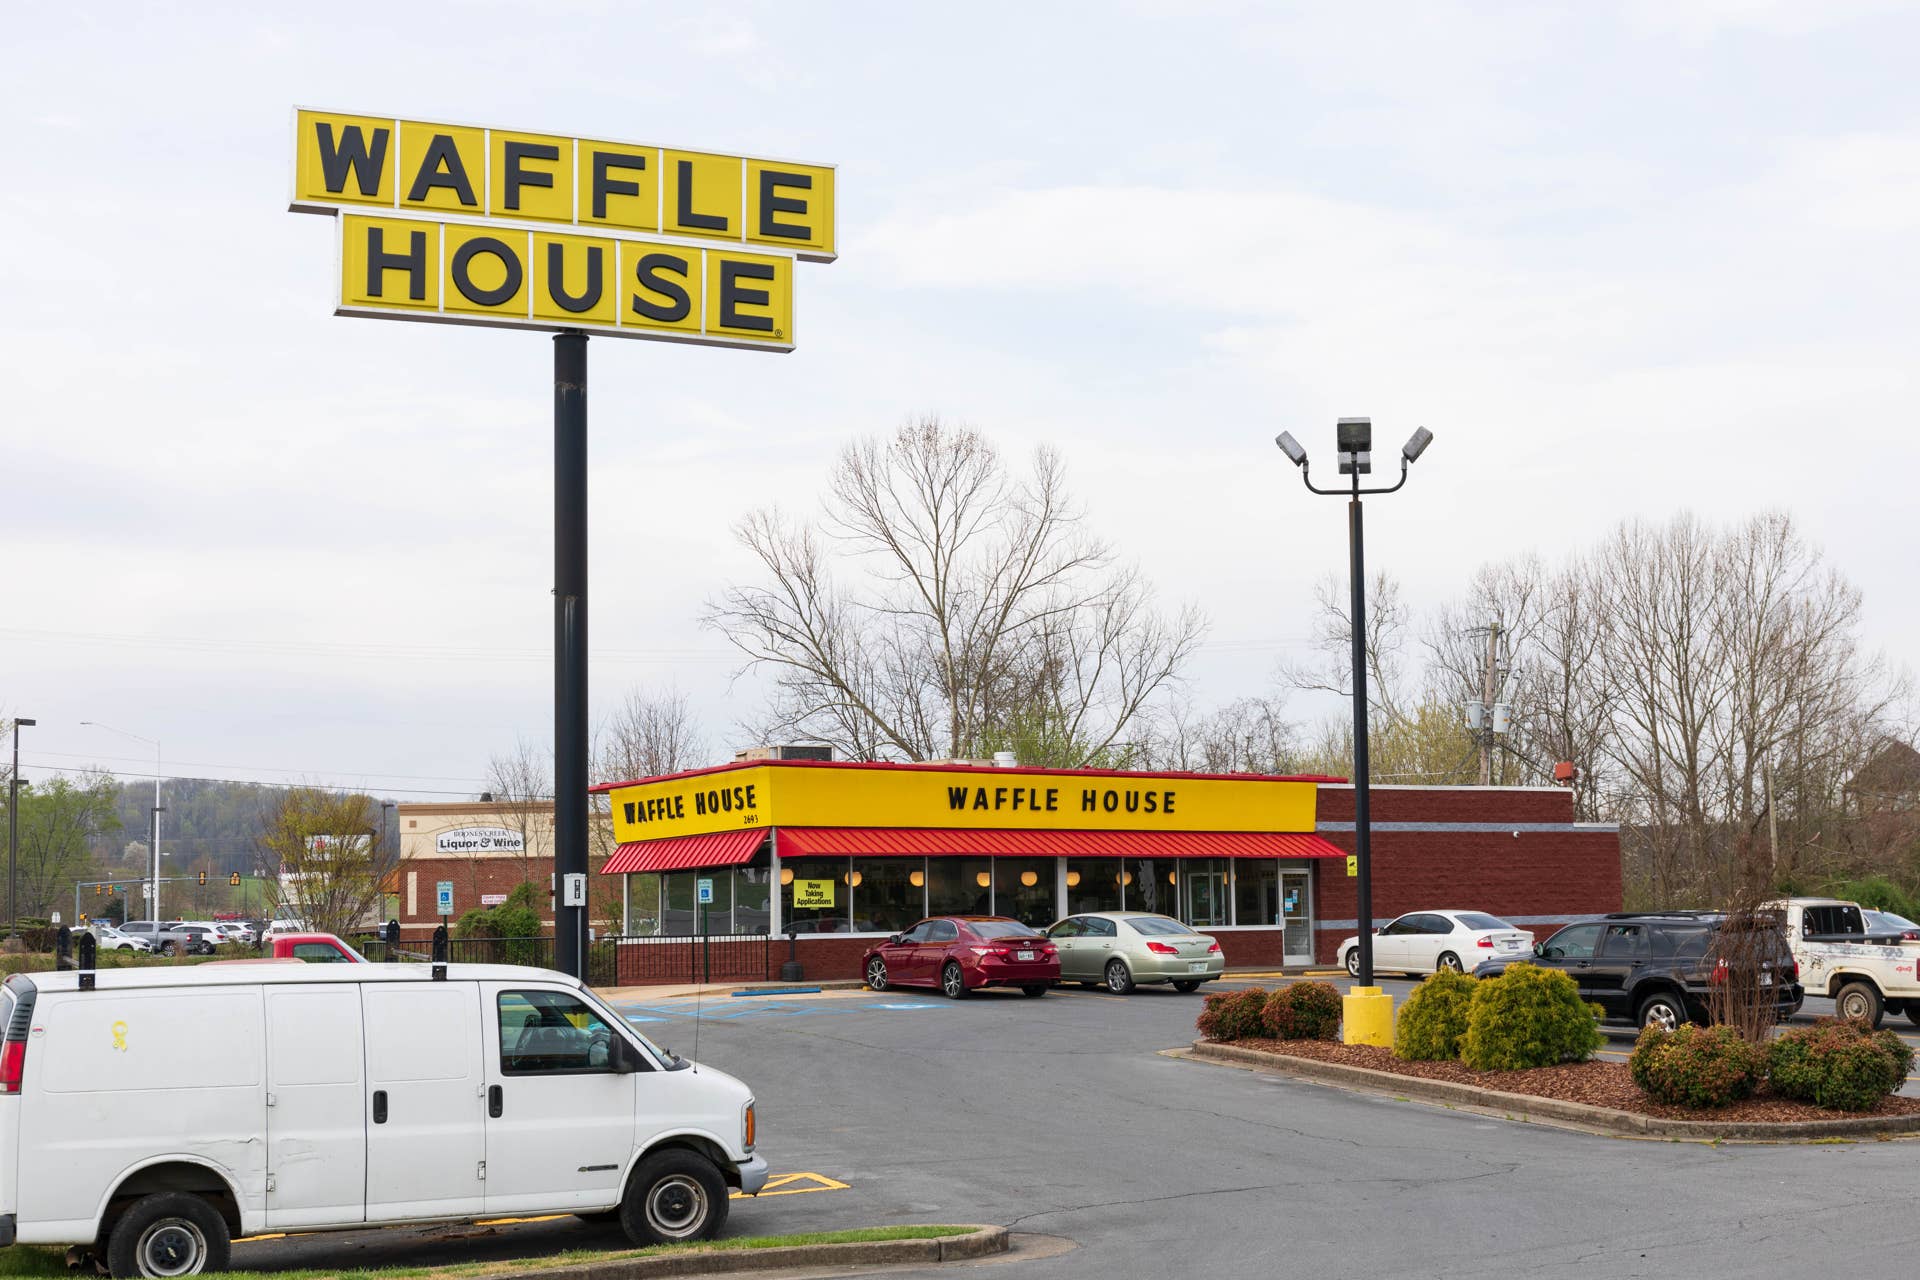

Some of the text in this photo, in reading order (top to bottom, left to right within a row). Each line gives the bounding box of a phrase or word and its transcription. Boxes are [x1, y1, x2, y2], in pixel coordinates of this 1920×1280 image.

[315, 122, 812, 240] WAFFLE
[366, 227, 774, 332] HOUSE
[623, 784, 757, 825] WAFFLE HOUSE
[947, 786, 1176, 813] WAFFLE HOUSE
[743, 814, 759, 825] 2693
[440, 837, 521, 850] Liquor & Wine
[807, 881, 821, 890] Now
[805, 889, 824, 898] Taking
[797, 897, 832, 906] Applications
